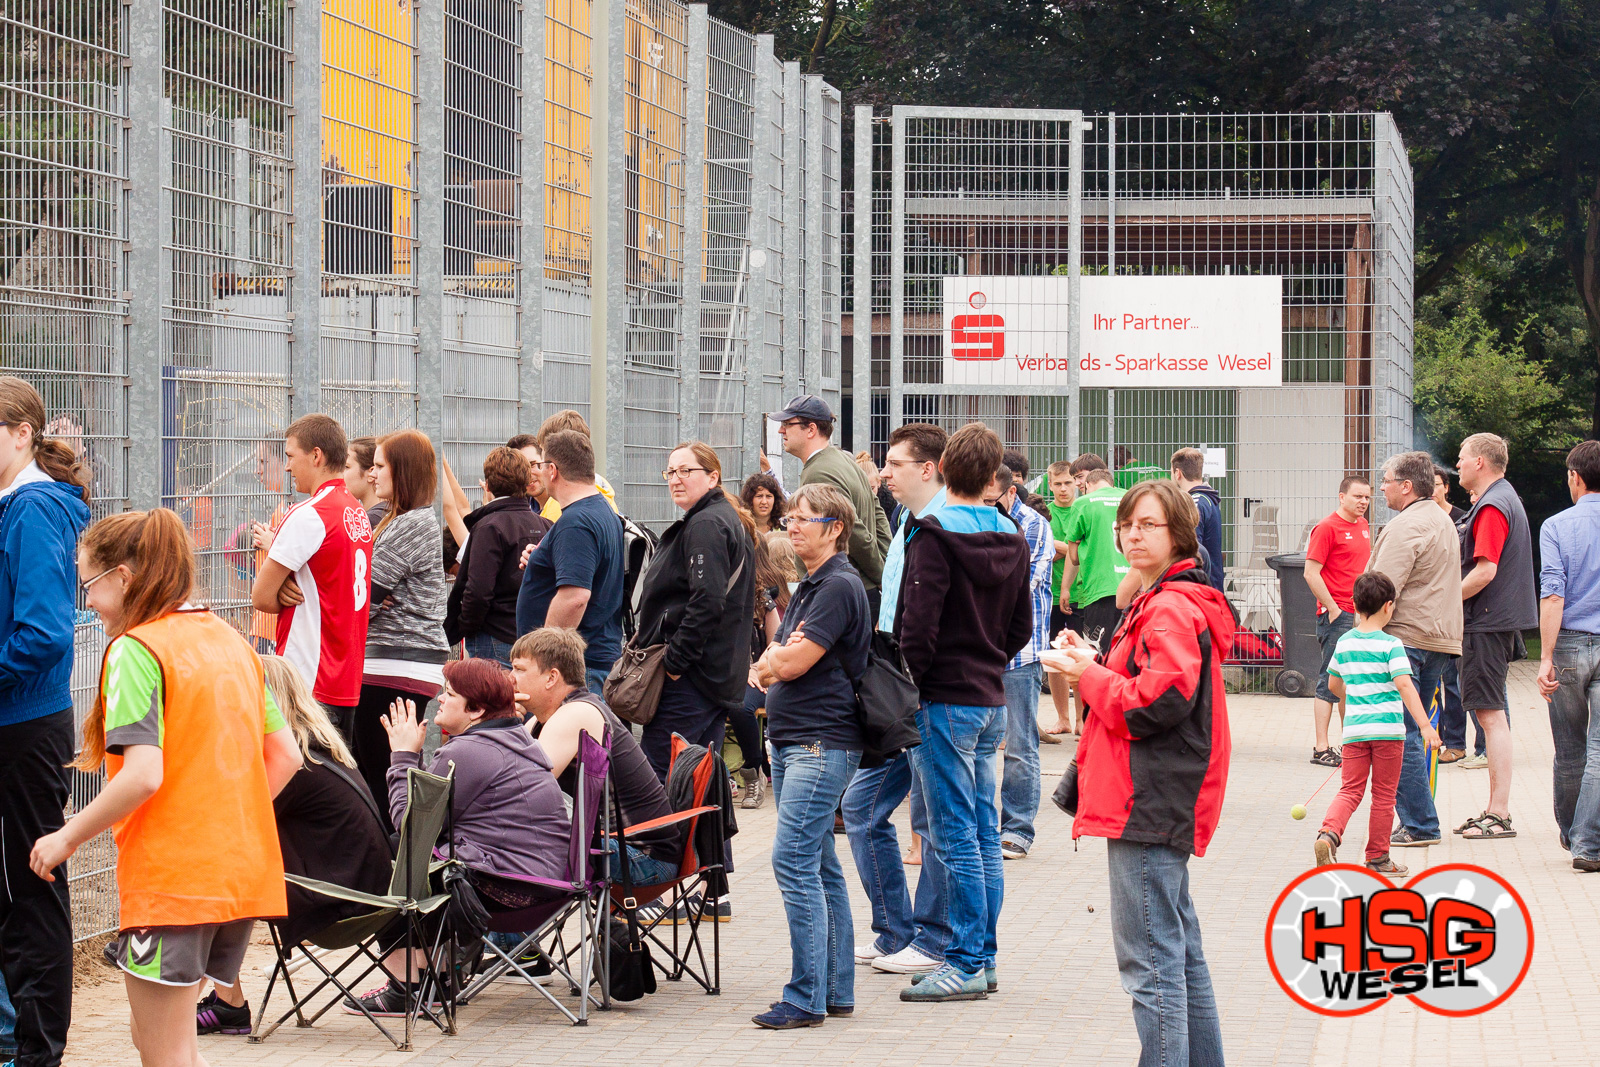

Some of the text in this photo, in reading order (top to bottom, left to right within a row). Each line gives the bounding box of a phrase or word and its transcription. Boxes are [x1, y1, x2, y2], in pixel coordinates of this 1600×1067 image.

[1093, 313, 1117, 331] Ihr
[1015, 353, 1101, 372] Verbads
[1115, 353, 1209, 375] Sparkasse
[1218, 352, 1272, 371] Wesel
[353, 548, 367, 612] 8
